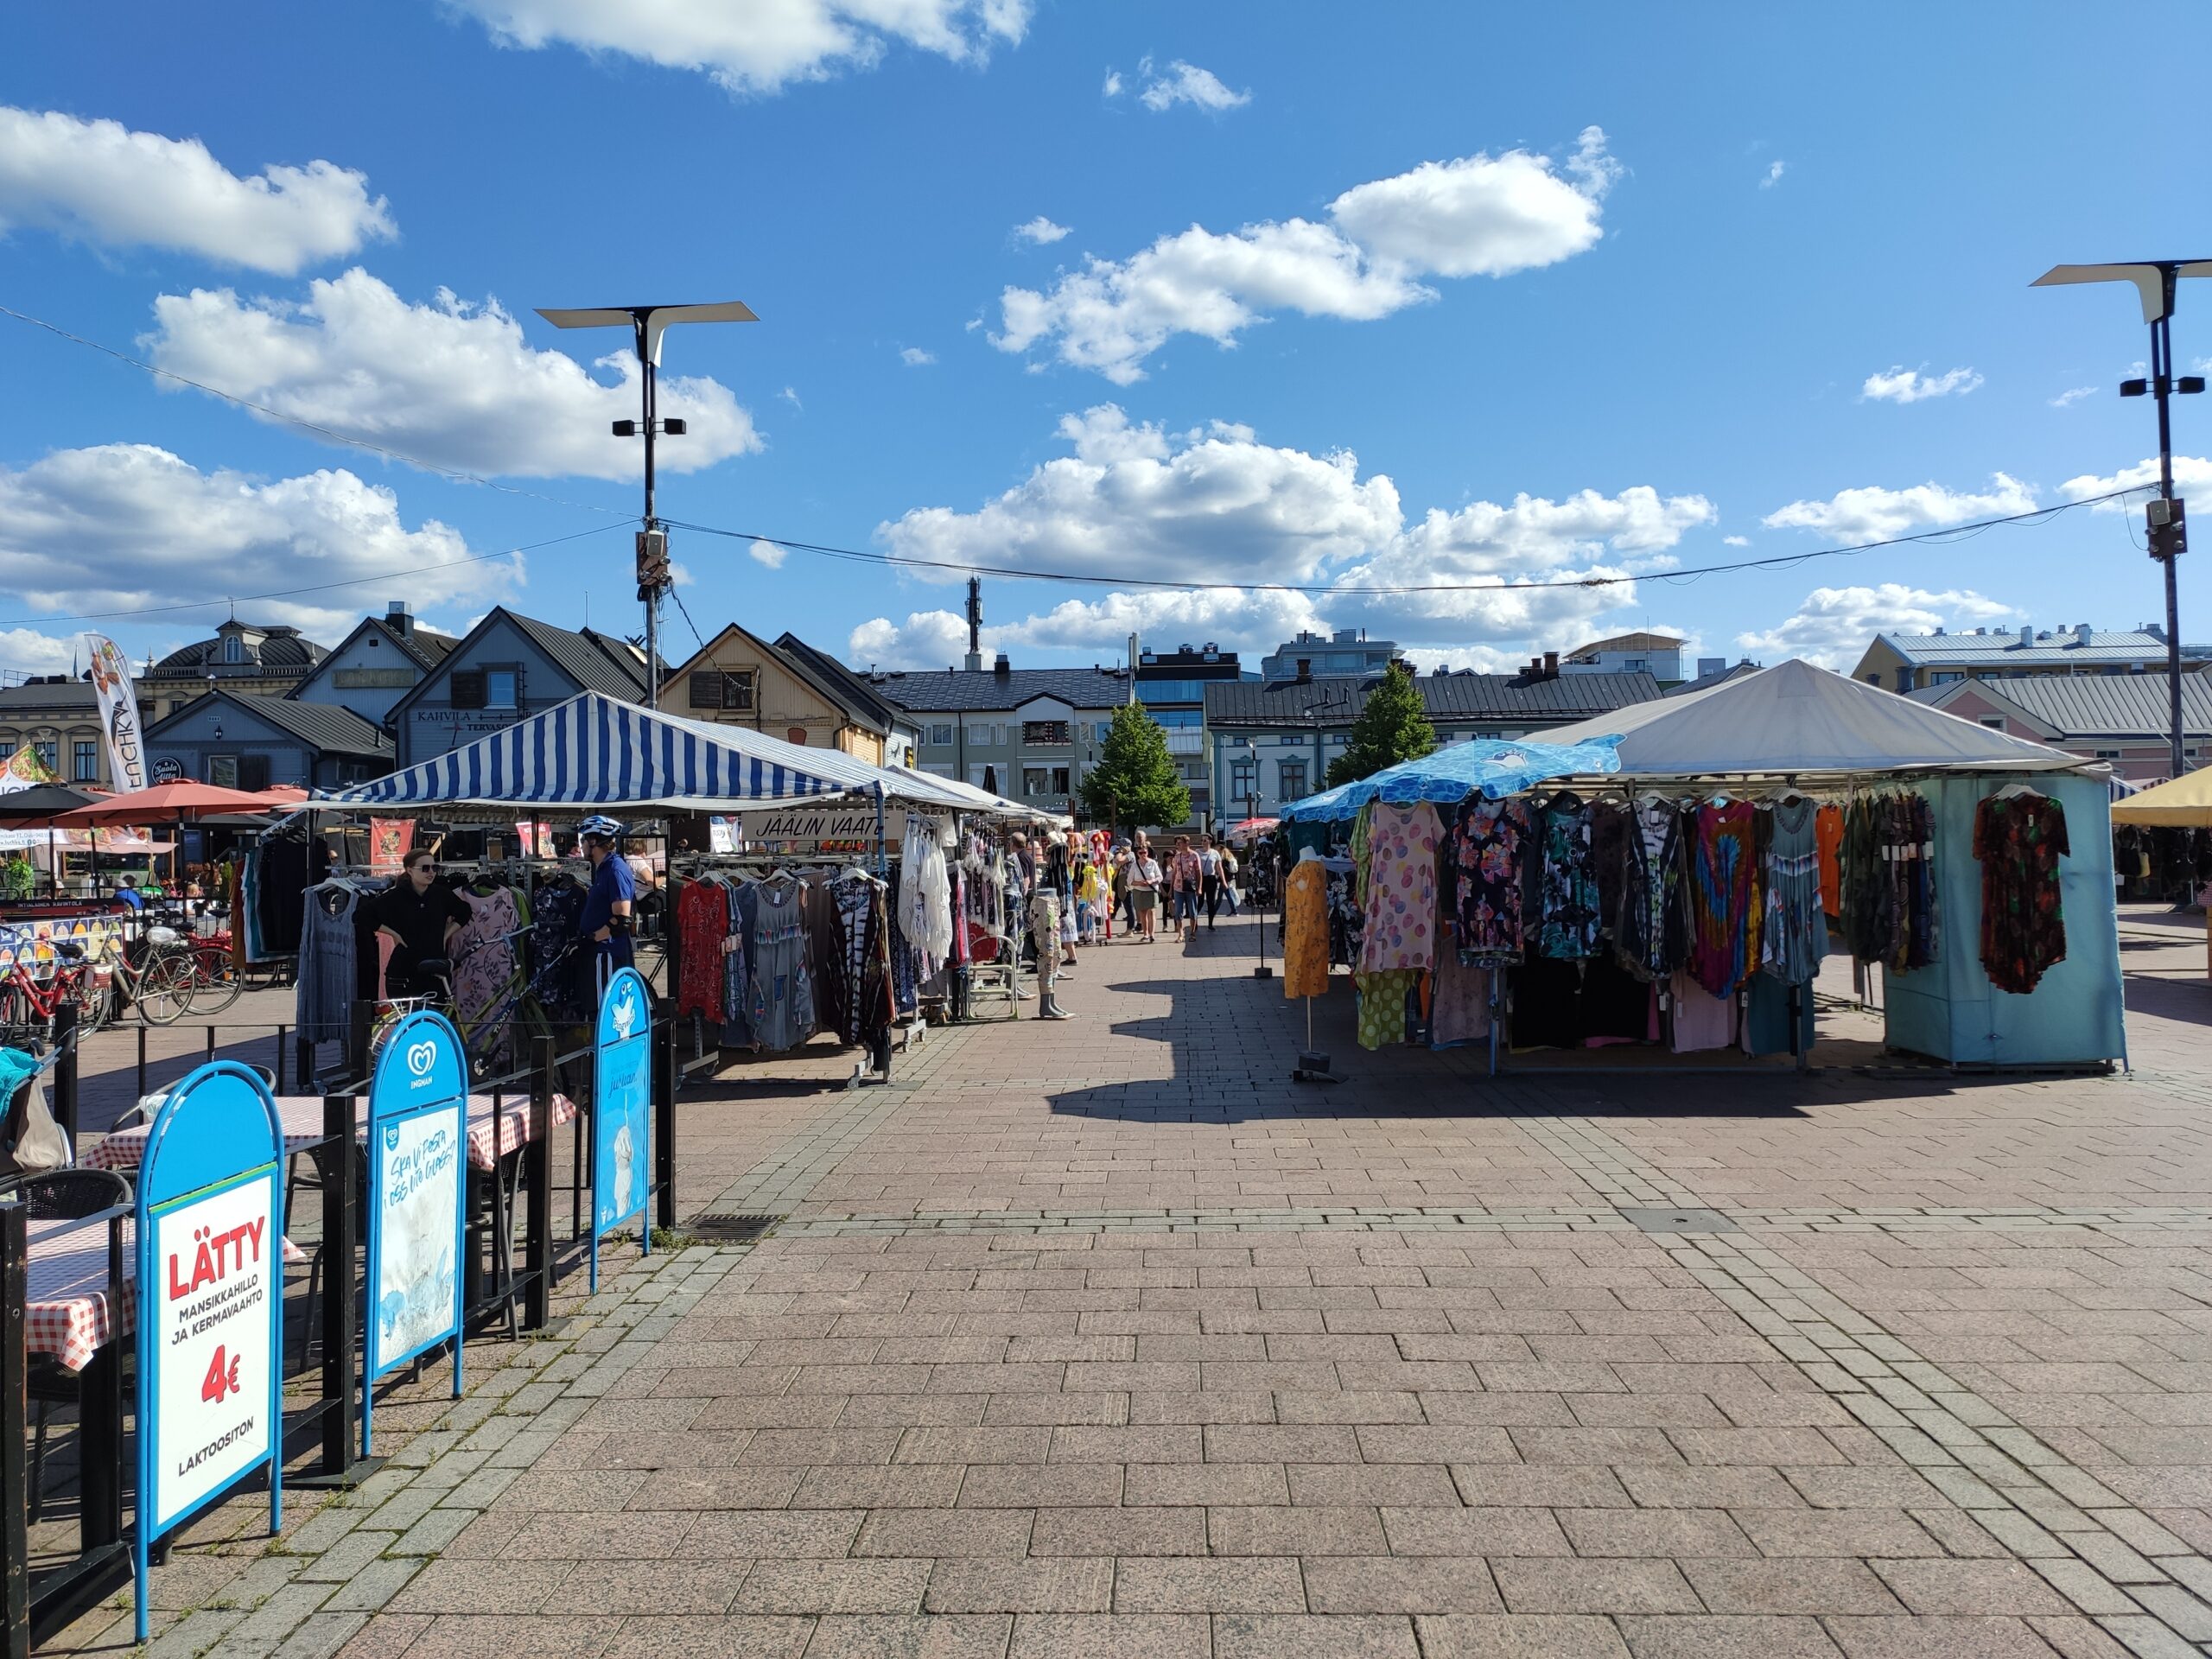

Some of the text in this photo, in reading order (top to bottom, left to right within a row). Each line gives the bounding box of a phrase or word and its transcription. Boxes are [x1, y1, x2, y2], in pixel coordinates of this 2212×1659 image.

[417, 711, 471, 721] KAHVILA
[154, 763, 177, 775] Suola
[756, 814, 826, 837] JÄÄLIN
[410, 1075, 433, 1090] INGMAN
[391, 1154, 410, 1185] SKA
[168, 1215, 265, 1301] LÄTTY
[171, 1288, 263, 1346] JA KERMAVAAHTO
[179, 1273, 258, 1324] MANSIKKAHILLO
[200, 1344, 241, 1404] 4€
[178, 1415, 254, 1478] LAKTOOSITON
